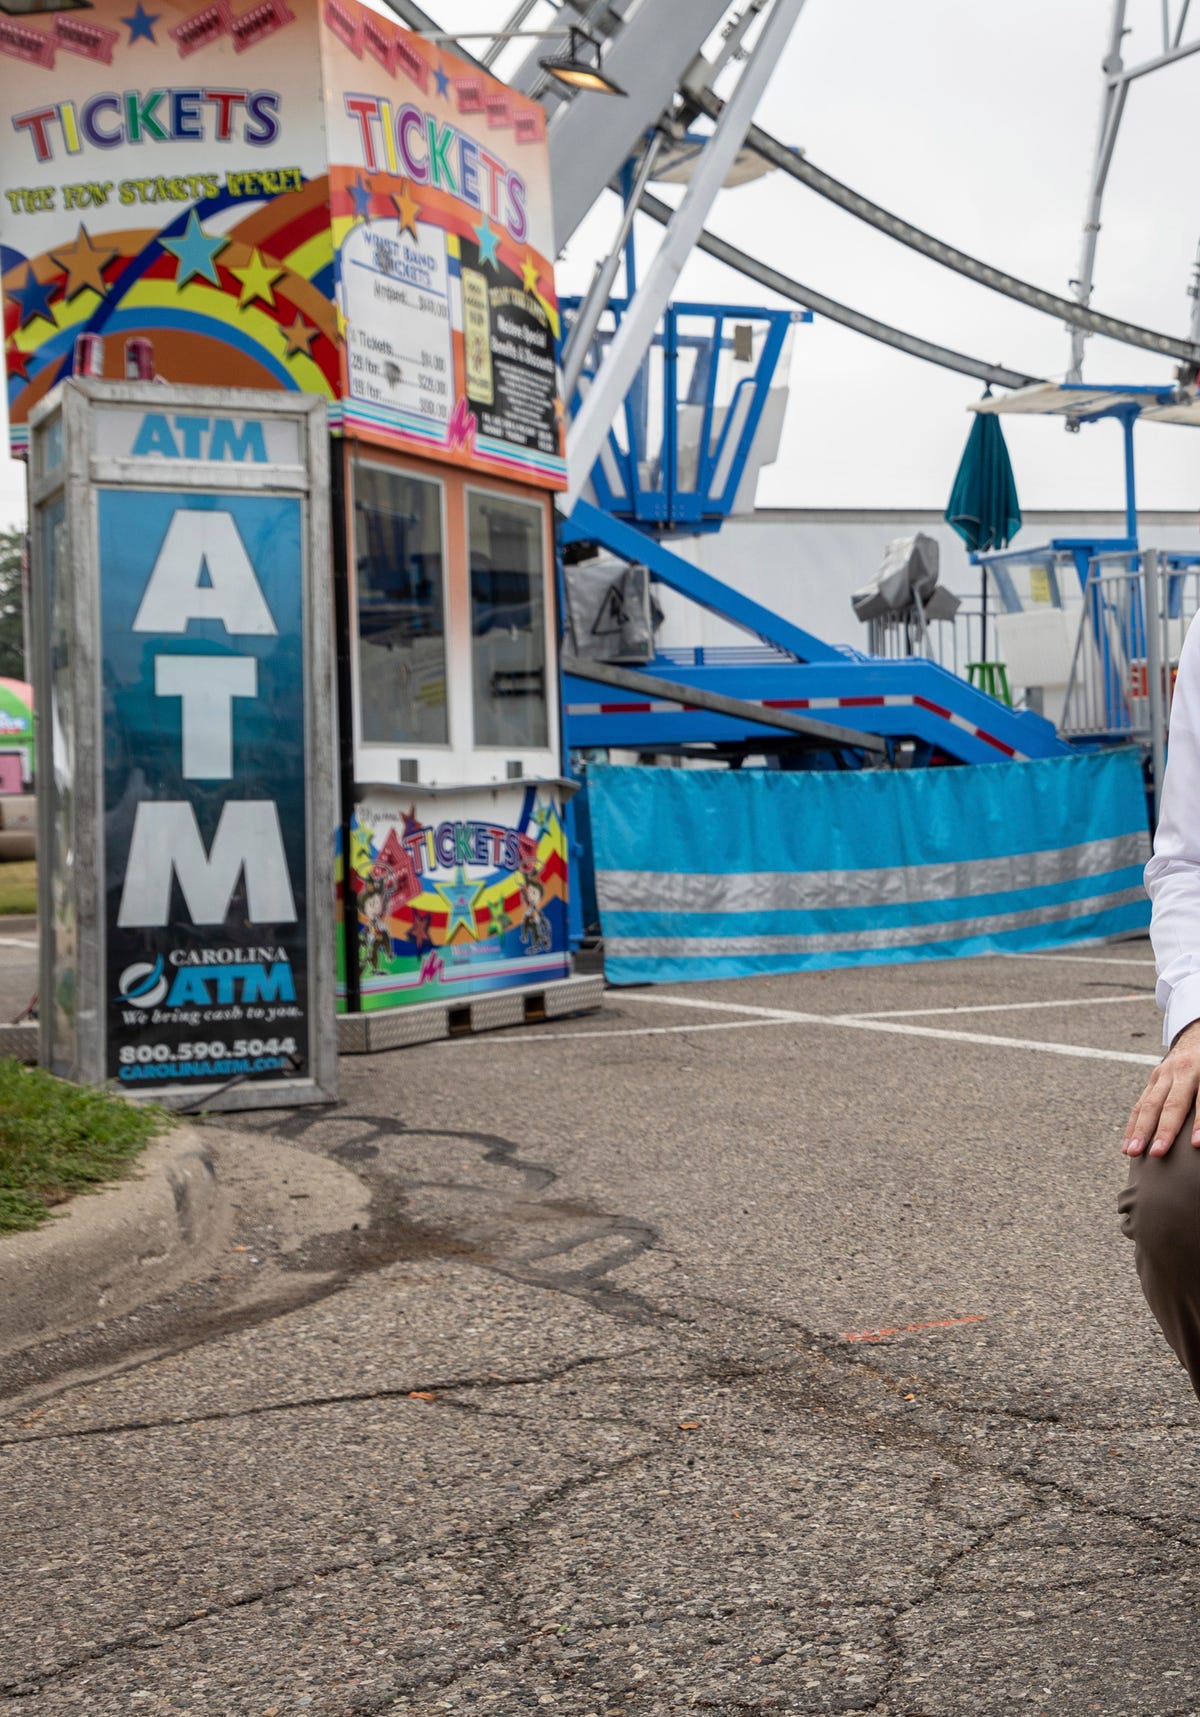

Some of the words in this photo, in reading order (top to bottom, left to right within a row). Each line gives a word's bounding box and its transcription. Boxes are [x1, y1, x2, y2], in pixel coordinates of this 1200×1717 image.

[11, 86, 281, 163] TICKETS
[344, 92, 527, 244] TICKETS
[5, 187, 56, 214] THE
[119, 172, 220, 205] STARTS
[131, 412, 269, 463] ATM
[402, 820, 521, 877] TICKETS
[169, 946, 289, 967] CAROLINA
[166, 961, 297, 1008] ATM
[122, 1010, 148, 1025] We
[151, 1008, 200, 1026] bring
[203, 1005, 243, 1021] cash
[246, 1007, 264, 1018] to
[265, 1005, 304, 1022] you.
[119, 1037, 297, 1064] 800.590.5044
